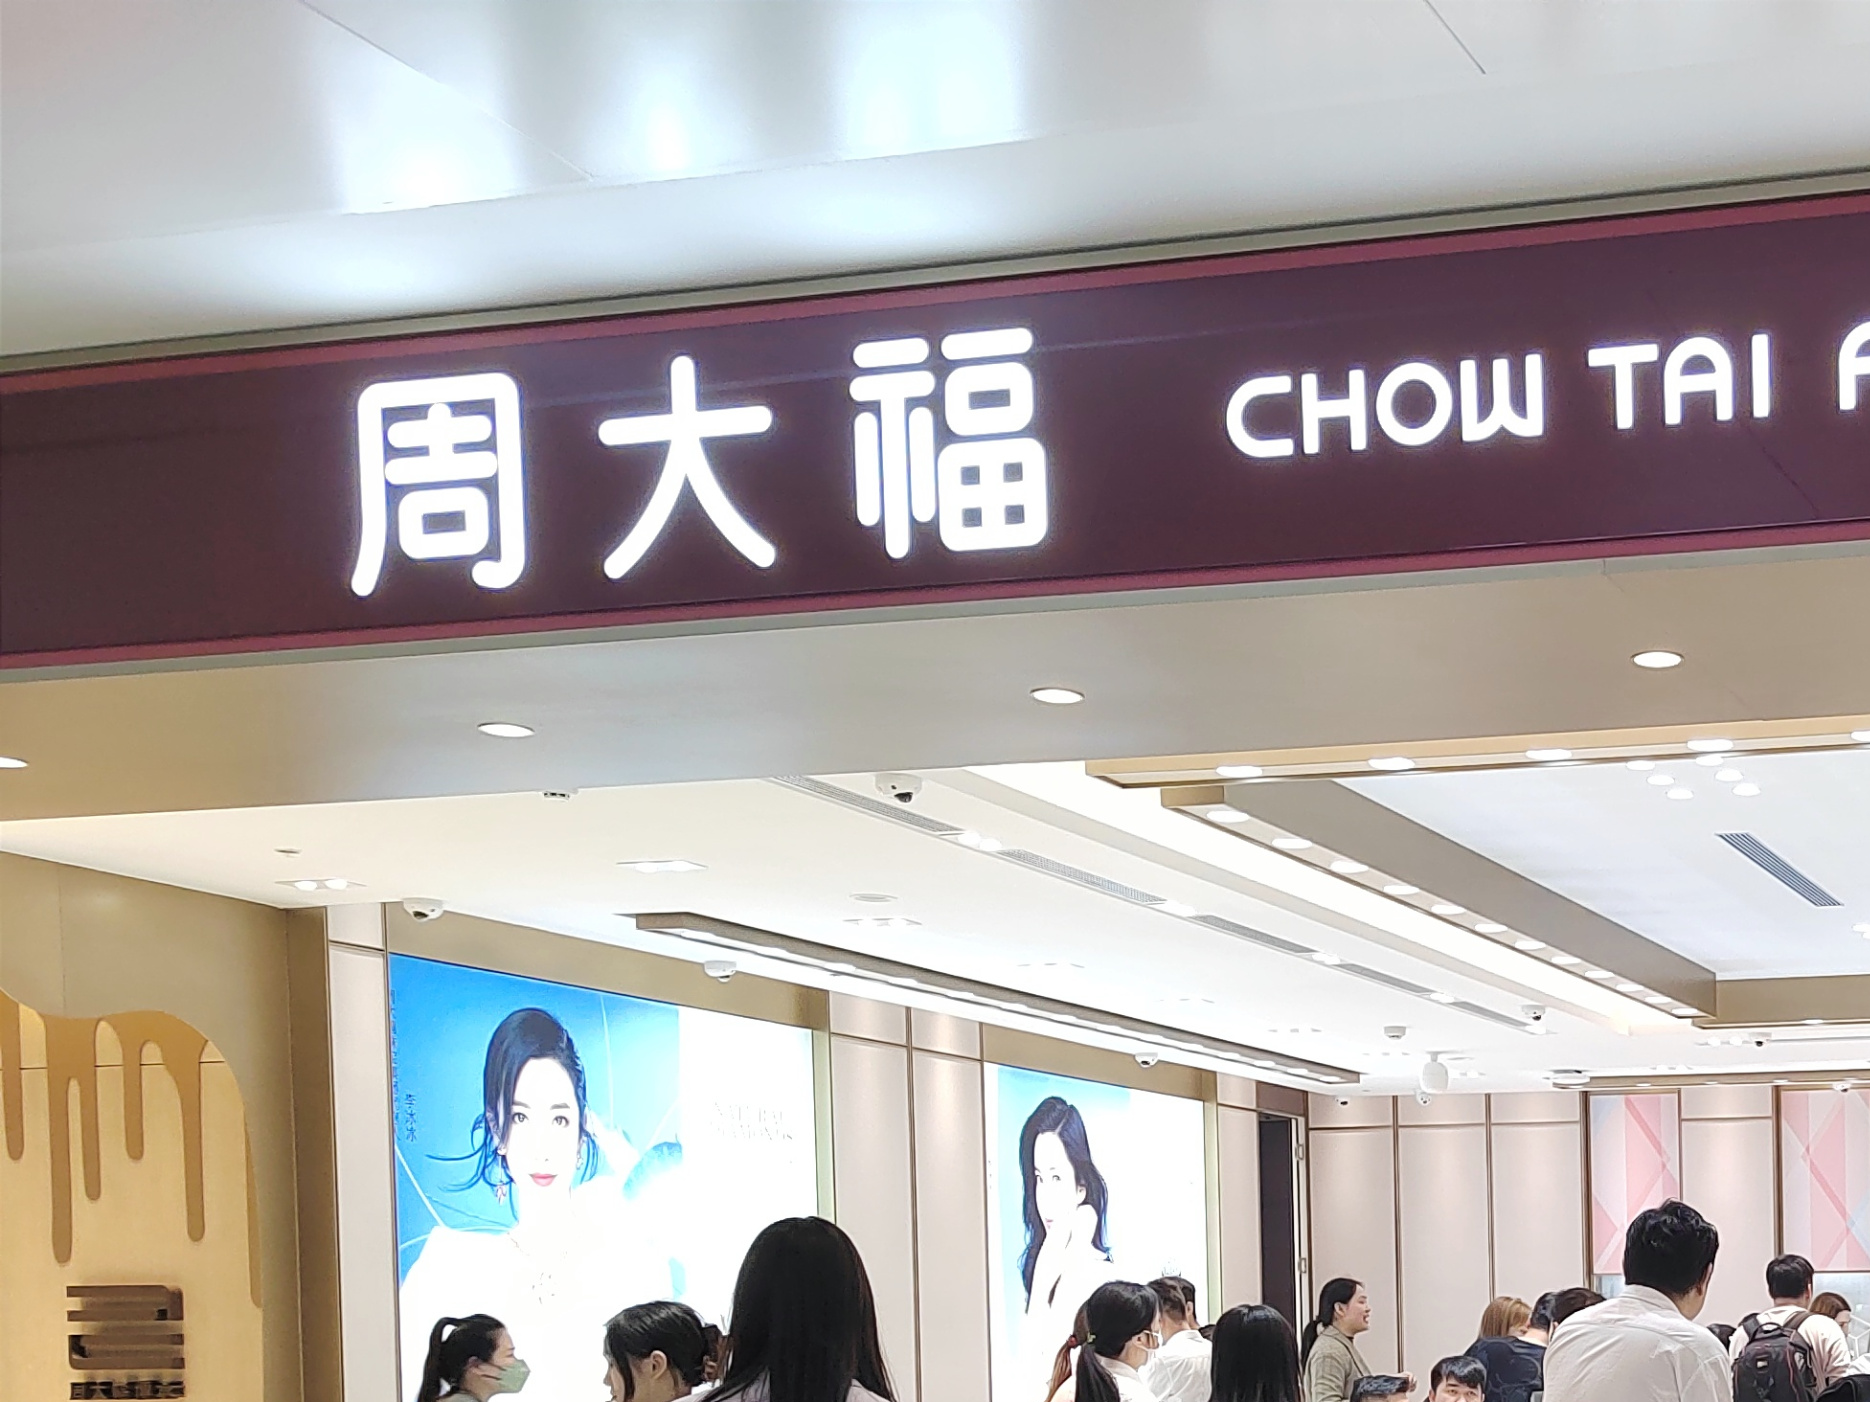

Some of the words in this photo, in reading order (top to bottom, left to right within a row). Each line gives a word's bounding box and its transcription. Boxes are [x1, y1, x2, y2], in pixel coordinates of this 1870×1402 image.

[350, 326, 1049, 597] 周大福
[1225, 351, 1545, 459] CHOW
[1587, 332, 1772, 431] TAI
